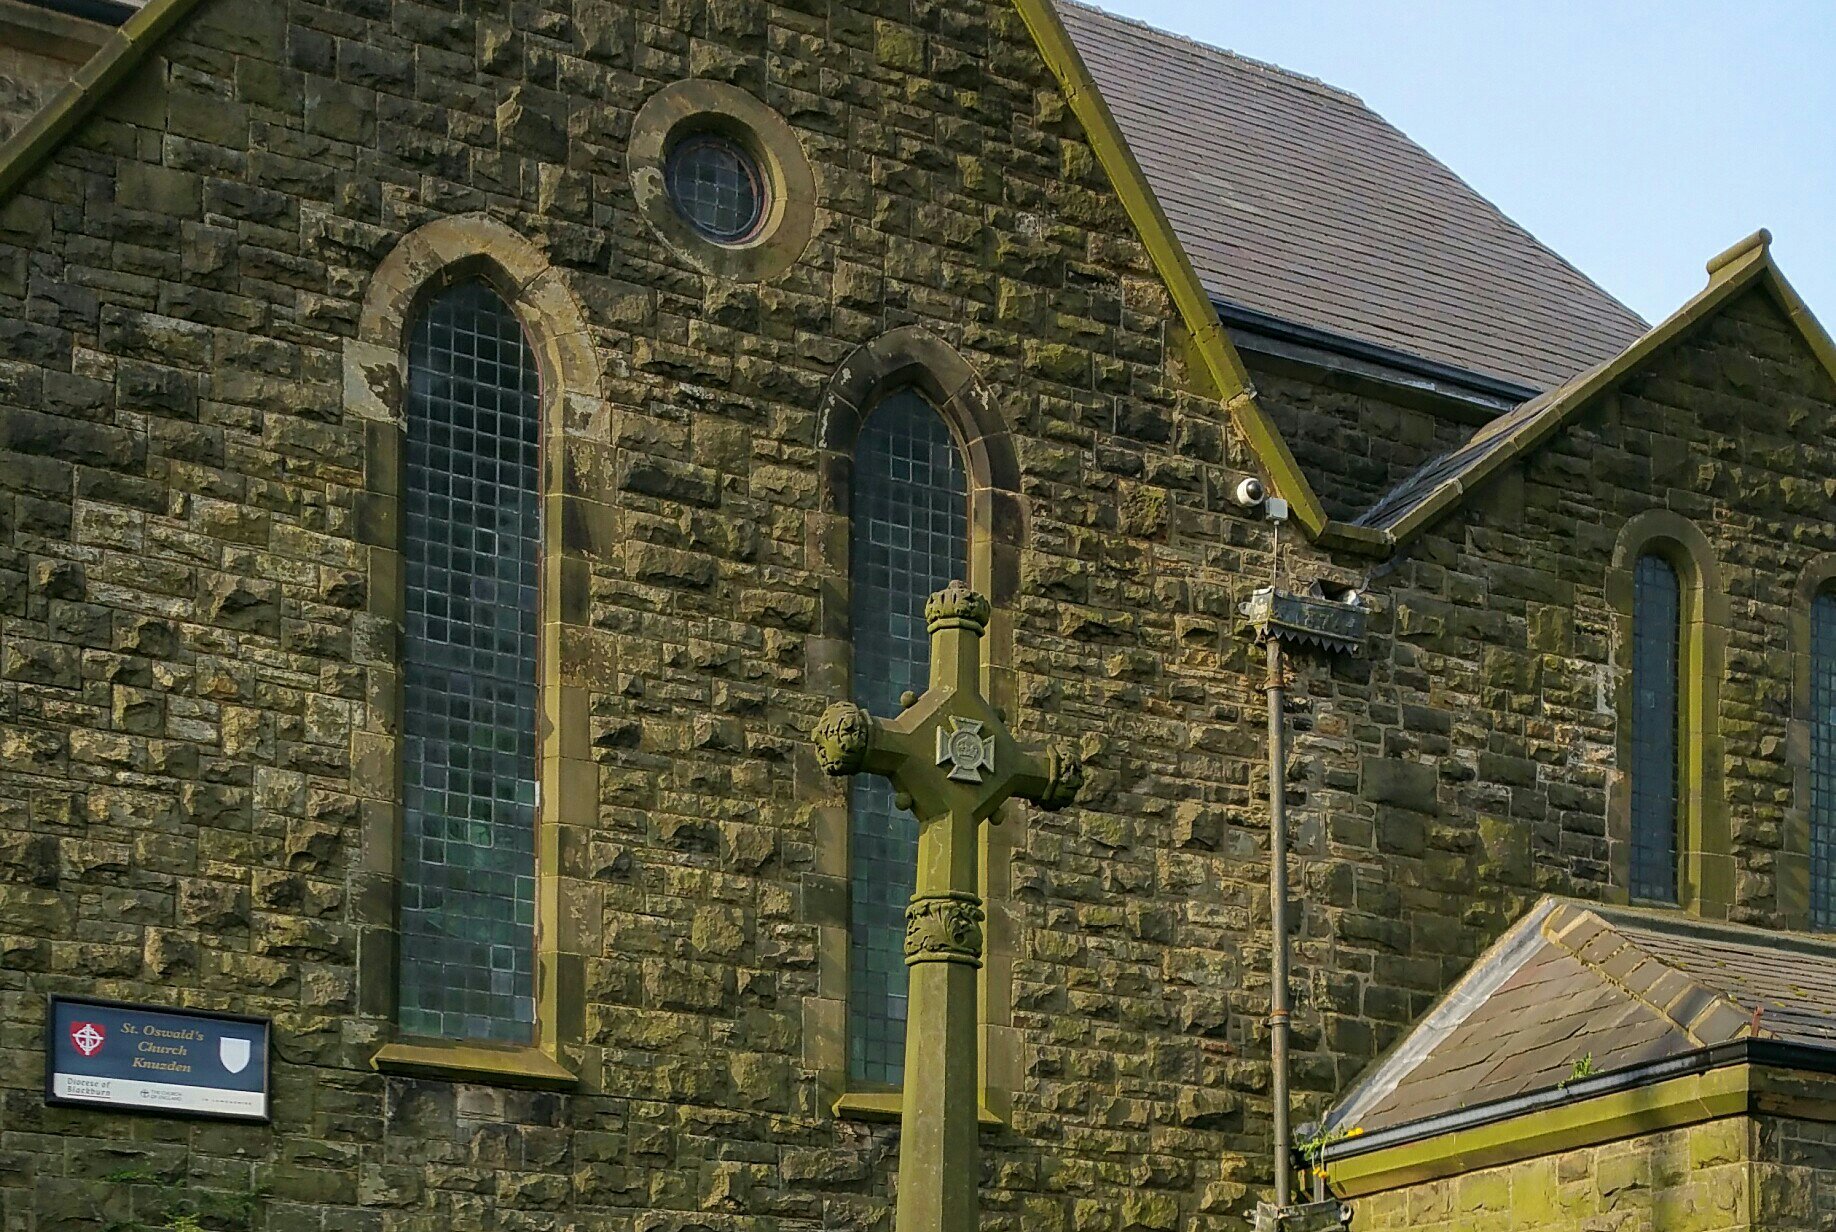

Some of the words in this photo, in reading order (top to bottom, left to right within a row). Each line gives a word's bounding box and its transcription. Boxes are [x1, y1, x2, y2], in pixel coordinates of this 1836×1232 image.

[121, 1022, 138, 1034] St.
[143, 1025, 205, 1041] Oswald's
[138, 1041, 188, 1056] Church
[132, 1057, 192, 1073] Knuzden
[67, 1077, 99, 1087] Diocese
[67, 1086, 111, 1096] Blackburn
